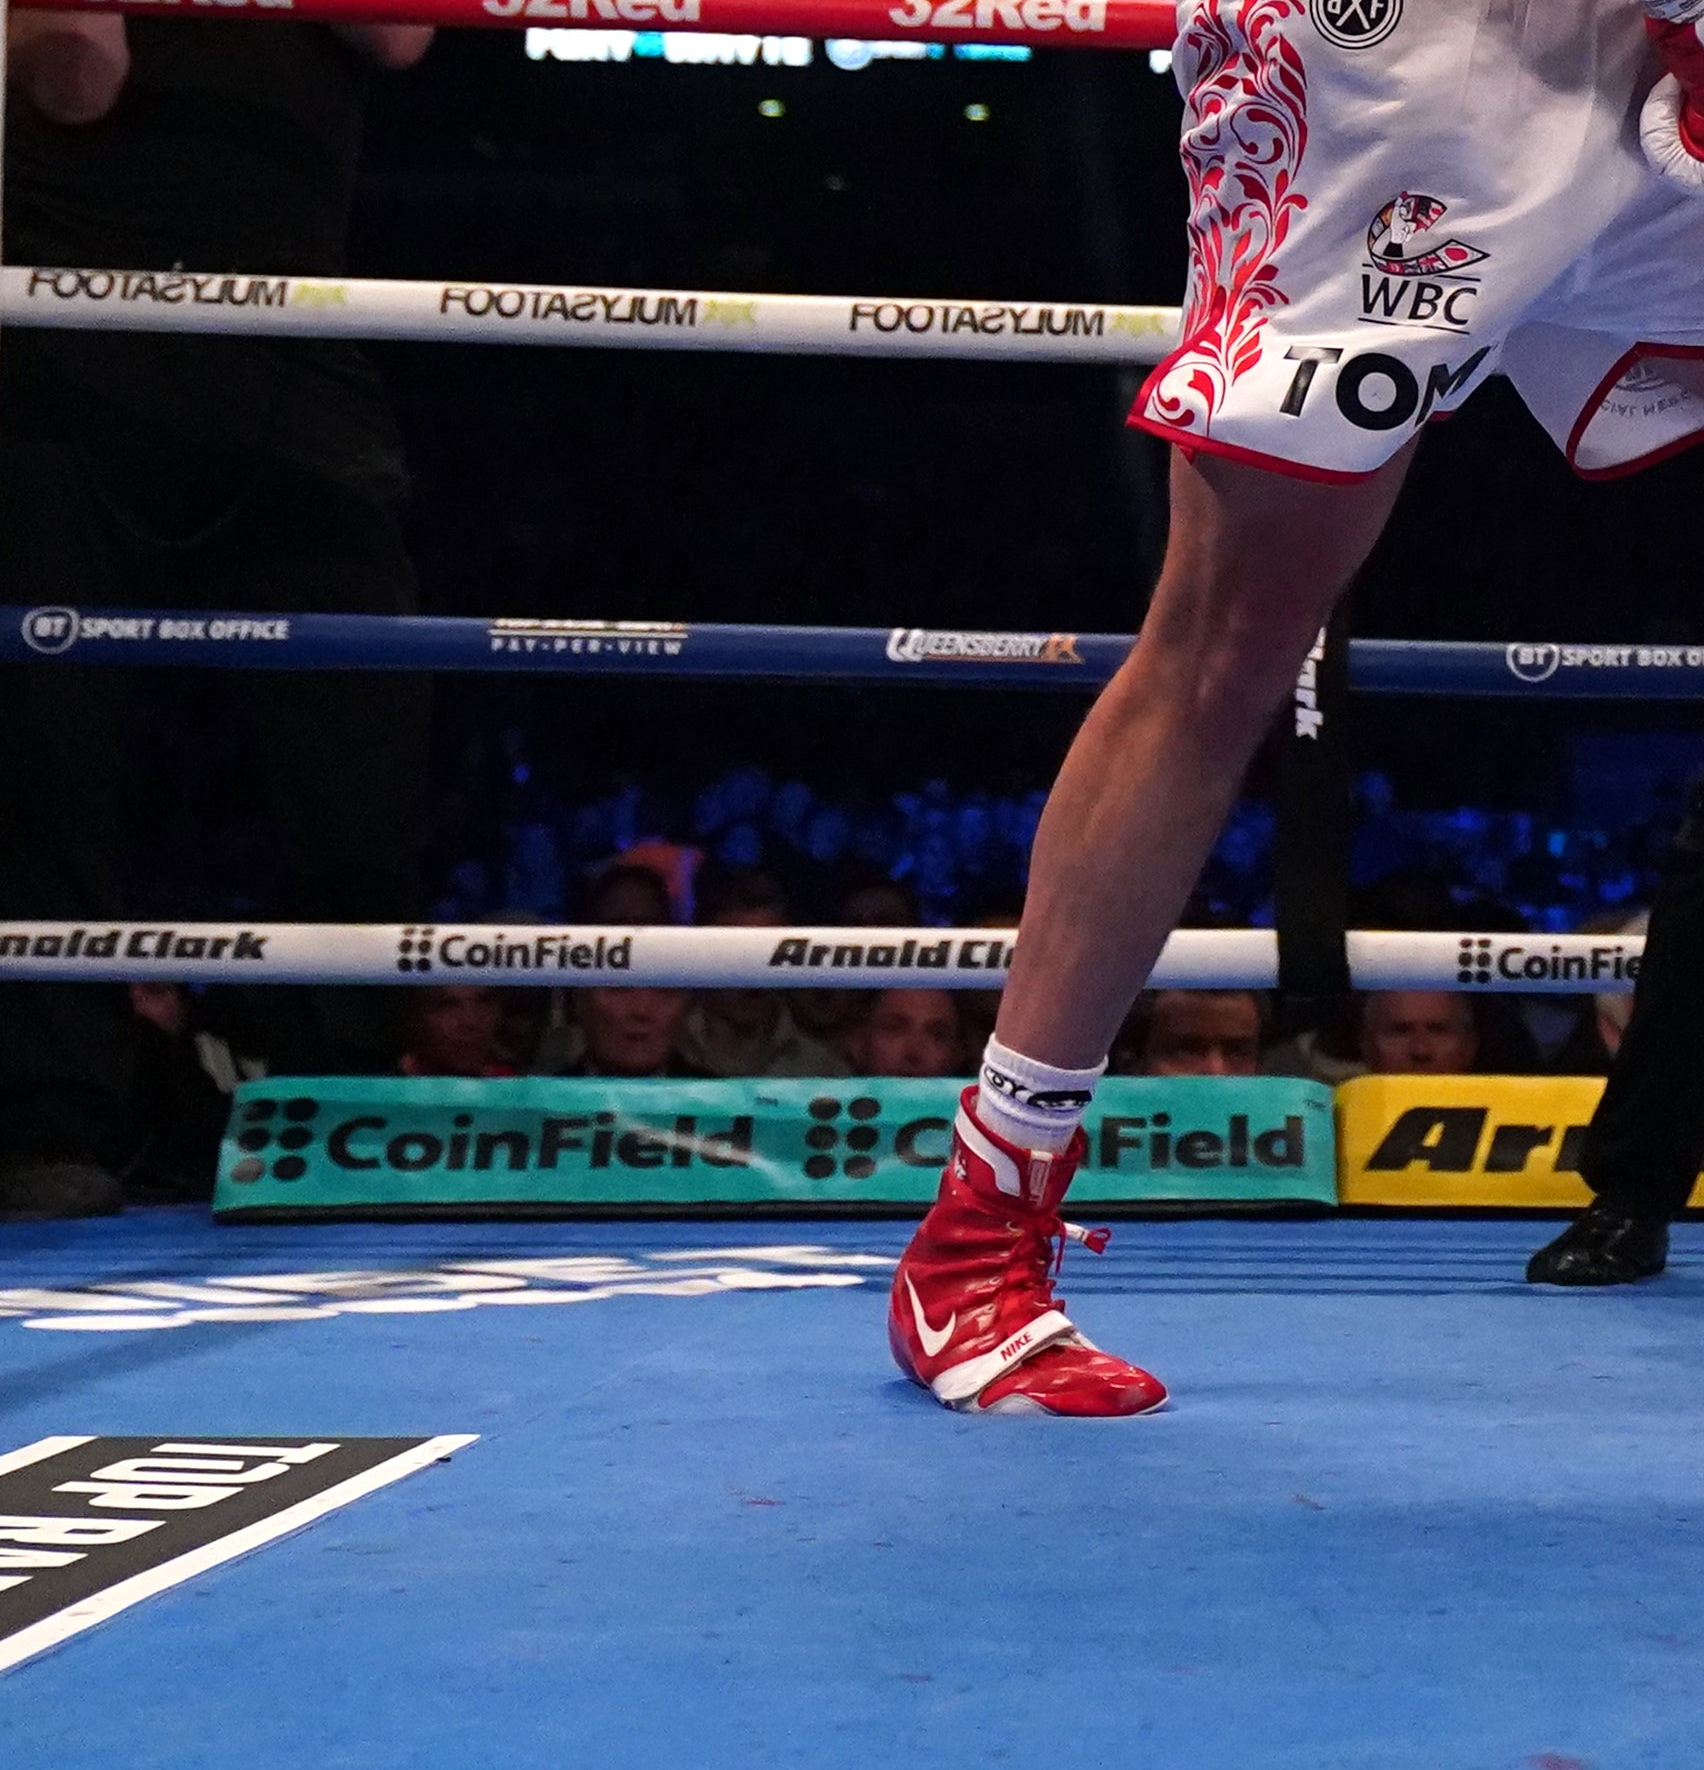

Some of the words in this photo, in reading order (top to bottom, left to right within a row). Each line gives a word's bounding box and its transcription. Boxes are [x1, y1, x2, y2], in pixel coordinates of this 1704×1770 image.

[440, 287, 698, 328] FOOTASYLUM
[1360, 273, 1478, 326] WBC
[849, 303, 1106, 338] FOOTASYLUM
[80, 617, 154, 641] SPORT
[158, 618, 206, 641] BOX
[208, 619, 291, 641] OFFICE
[491, 636, 682, 656] PAY-PER-VIEW
[1561, 646, 1632, 668] SPORT
[1635, 647, 1683, 668] BOX
[124, 931, 269, 961] Clark
[438, 935, 633, 971] CoinField
[769, 938, 952, 969] Arnold
[328, 1112, 755, 1172] CoinField
[894, 1112, 1305, 1172] CField
[1000, 1331, 1033, 1362] NIKE
[51, 1442, 341, 1511] TOP
